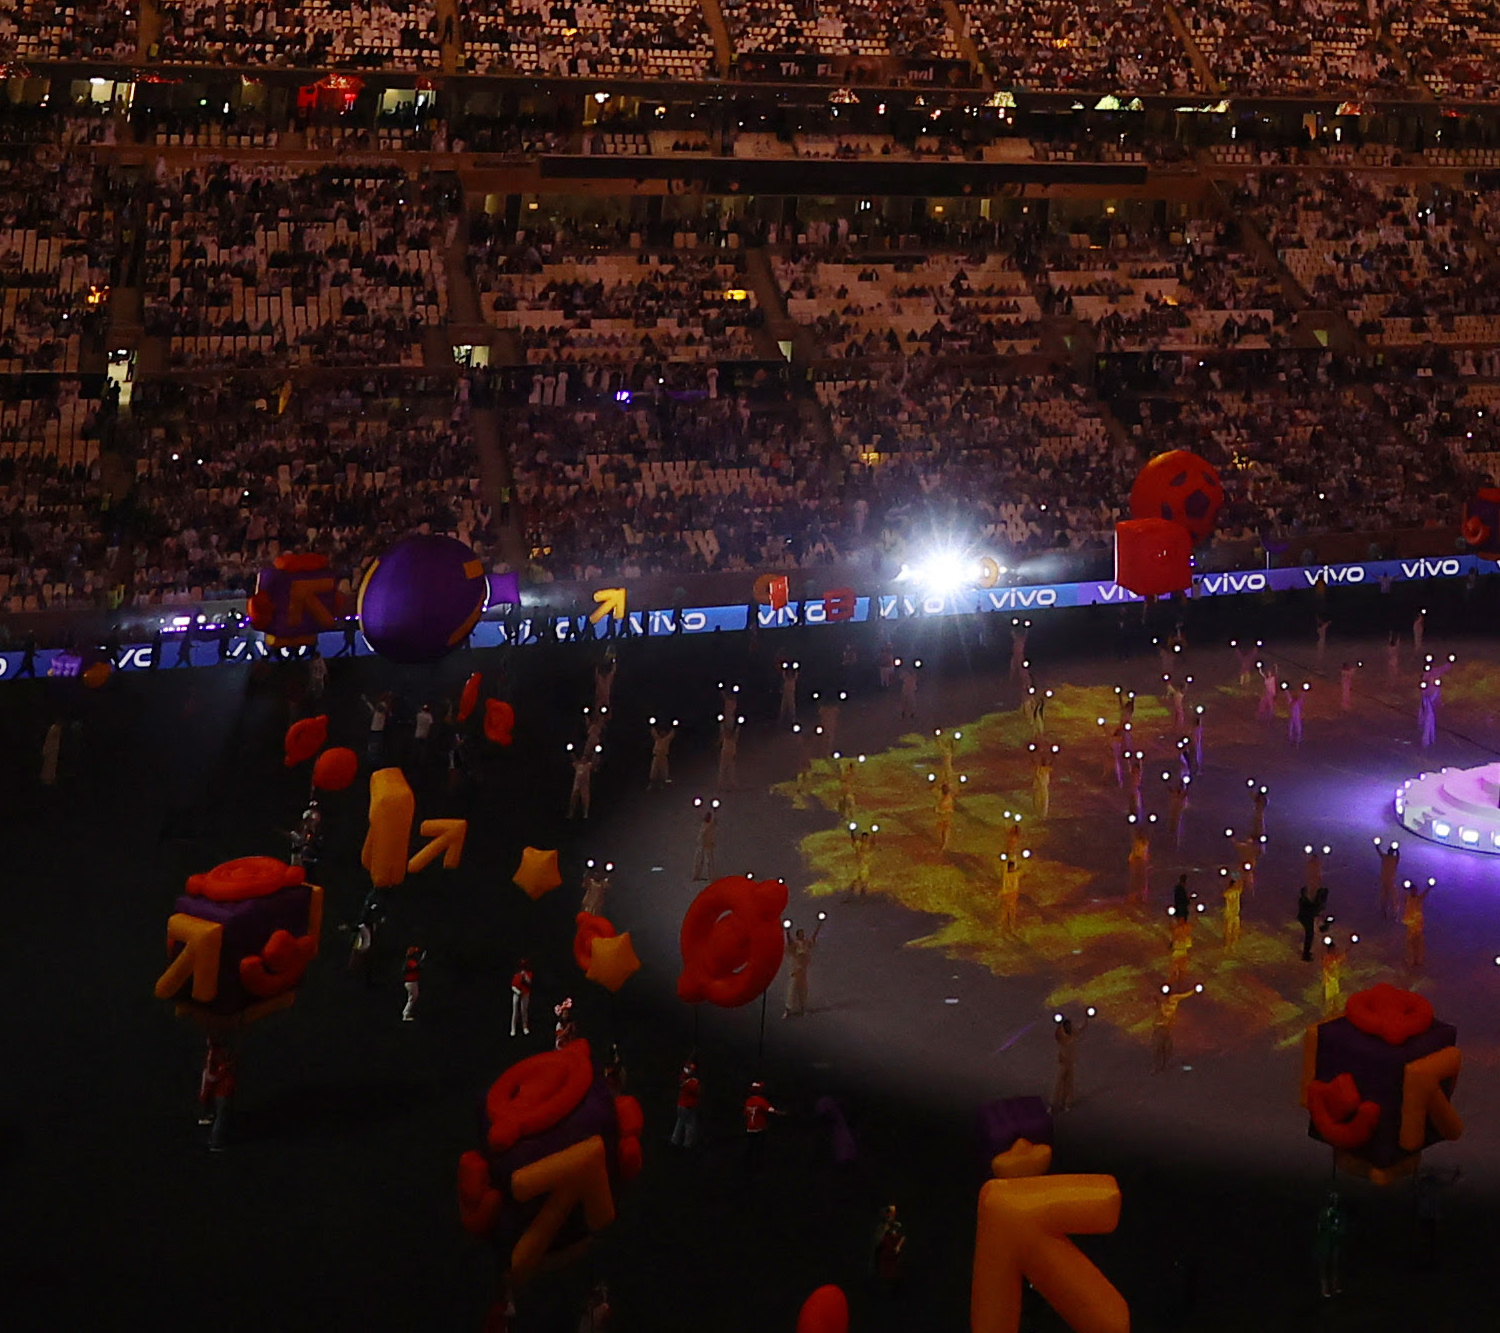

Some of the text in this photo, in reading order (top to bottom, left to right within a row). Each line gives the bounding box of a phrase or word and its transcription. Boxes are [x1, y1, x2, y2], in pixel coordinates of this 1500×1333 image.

[989, 587, 1057, 609] vivo
[1204, 572, 1266, 594] vivo
[1304, 565, 1365, 586] vivo
[1401, 558, 1459, 579] vivo
